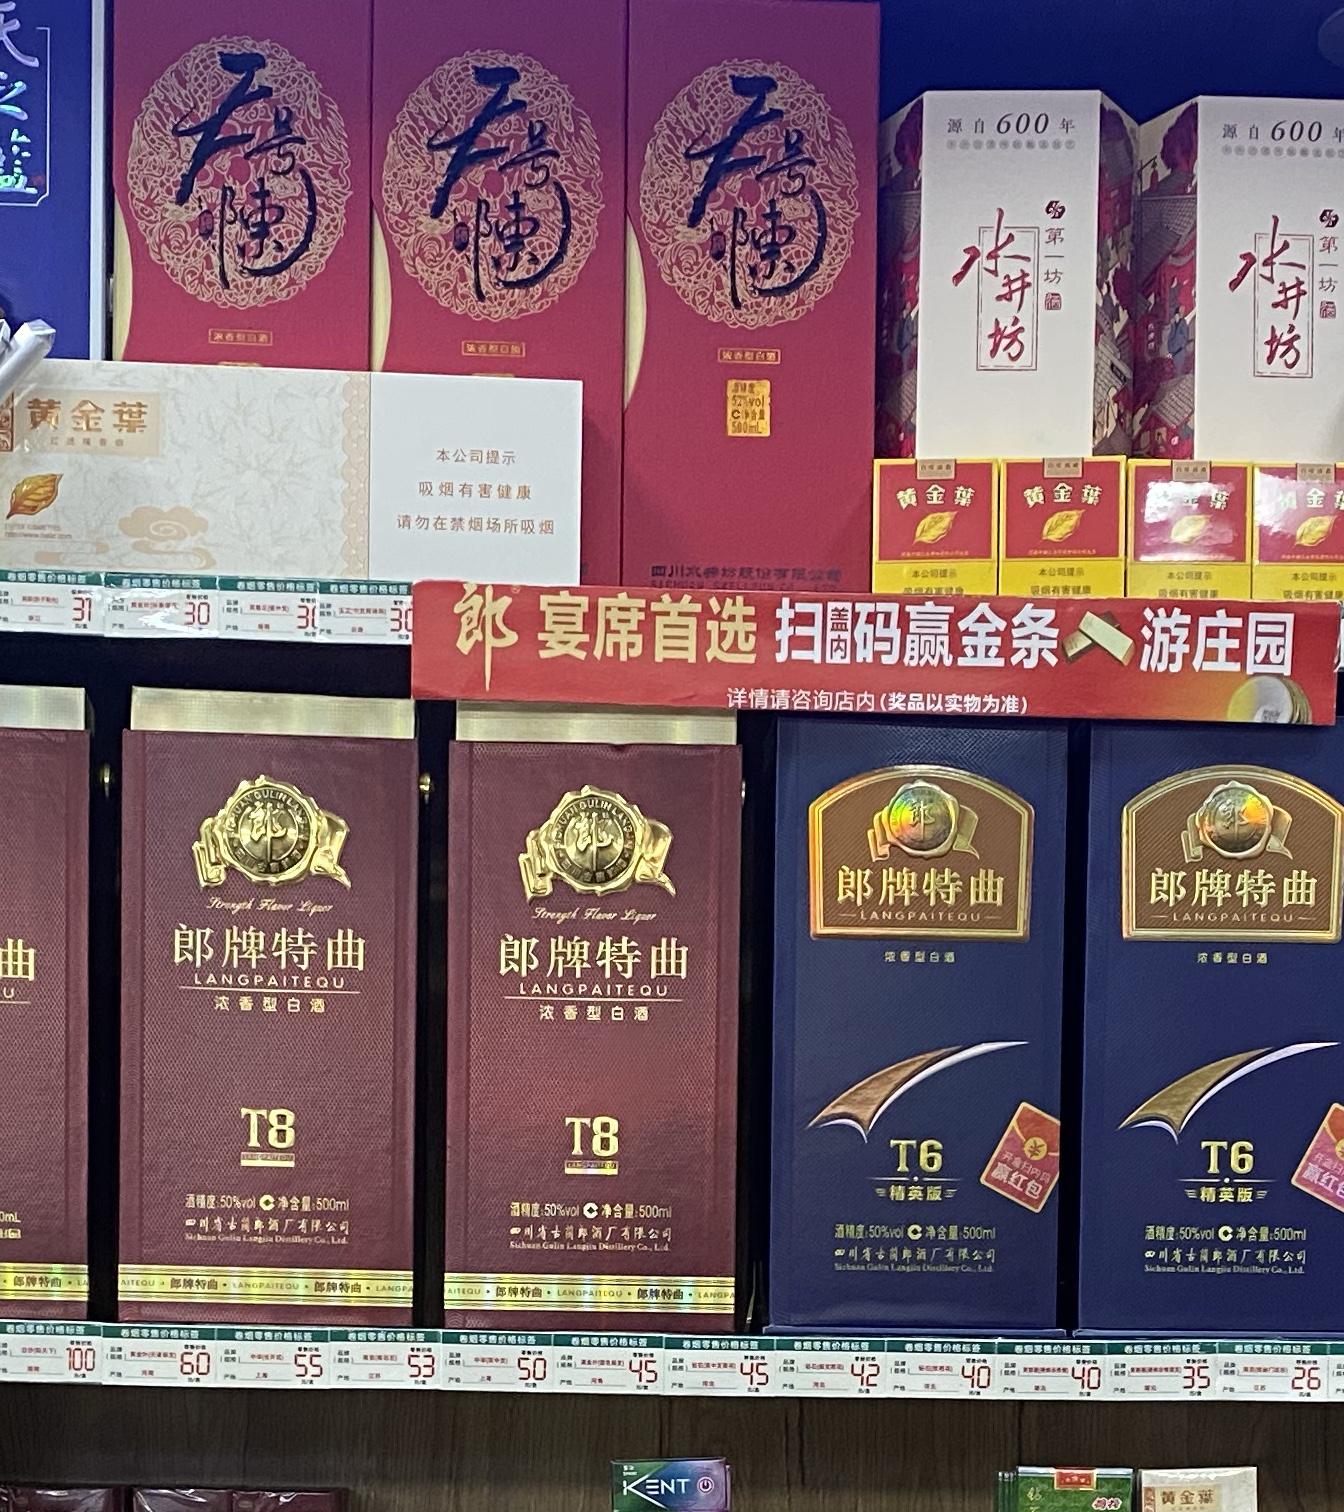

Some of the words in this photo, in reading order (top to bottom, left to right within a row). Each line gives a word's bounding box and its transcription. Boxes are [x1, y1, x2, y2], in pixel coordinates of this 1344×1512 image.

[952, 208, 1033, 362] 水井坊
[1229, 215, 1306, 368] 水井坊
[435, 448, 517, 466] 本公司提示
[418, 480, 532, 500] 吸烟有害健康
[396, 512, 555, 537] 请勿在禁烟场所吸烟
[184, 602, 211, 626] 30
[538, 594, 758, 663] 宴席首选
[1139, 607, 1296, 676] 游庄园
[835, 865, 1005, 909] 郎牌特曲
[1149, 866, 1318, 909] 郎牌特曲
[173, 924, 366, 972] 郎牌特曲
[498, 934, 689, 981] 郎牌特曲
[194, 972, 346, 988] LANGPAITEQU
[539, 1004, 650, 1023] 浓香型白酒
[241, 1107, 295, 1150] T8
[565, 1116, 619, 1158] T8
[889, 1139, 943, 1174] T6
[1200, 1140, 1254, 1175] T6
[1200, 1186, 1254, 1203] 精英版
[180, 1352, 210, 1376] 60
[294, 1354, 323, 1378] 55
[407, 1355, 435, 1378] 53
[517, 1357, 547, 1381] 50
[628, 1360, 658, 1383] 45
[851, 1364, 880, 1387] 42
[962, 1366, 991, 1389] 40
[1182, 1366, 1210, 1389] 35
[1292, 1367, 1321, 1390] 26
[622, 1474, 691, 1509] KENT
